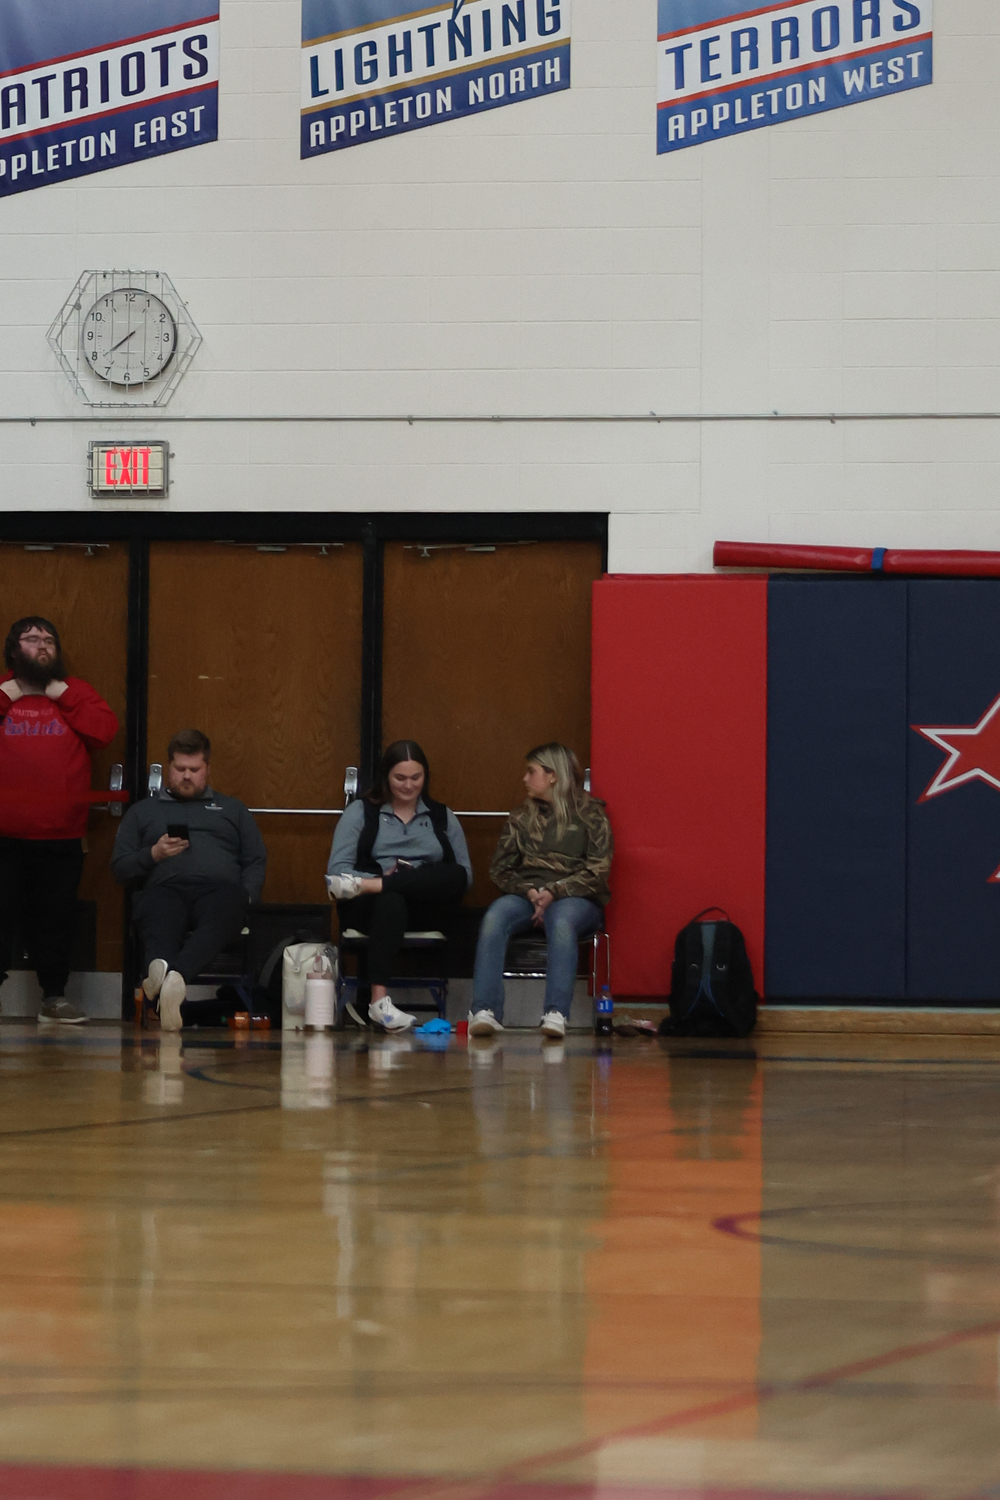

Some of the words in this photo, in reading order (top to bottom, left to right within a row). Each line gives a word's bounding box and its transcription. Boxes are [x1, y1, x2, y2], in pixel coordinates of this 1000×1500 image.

[667, 74, 826, 142] APPLETON
[842, 50, 924, 95] WEST
[309, 85, 453, 148] APPLETON
[468, 56, 562, 103] NORTH
[133, 105, 206, 150] EAST
[104, 298, 114, 307] 11
[124, 293, 136, 302] 12
[91, 312, 102, 321] 10
[159, 313, 166, 323] 2
[87, 331, 94, 341] 9
[163, 333, 170, 342] 3
[91, 351, 98, 361] 8
[104, 366, 111, 376] 7
[143, 367, 150, 377] 5
[123, 372, 130, 381] 6
[105, 448, 152, 485] EXIT
